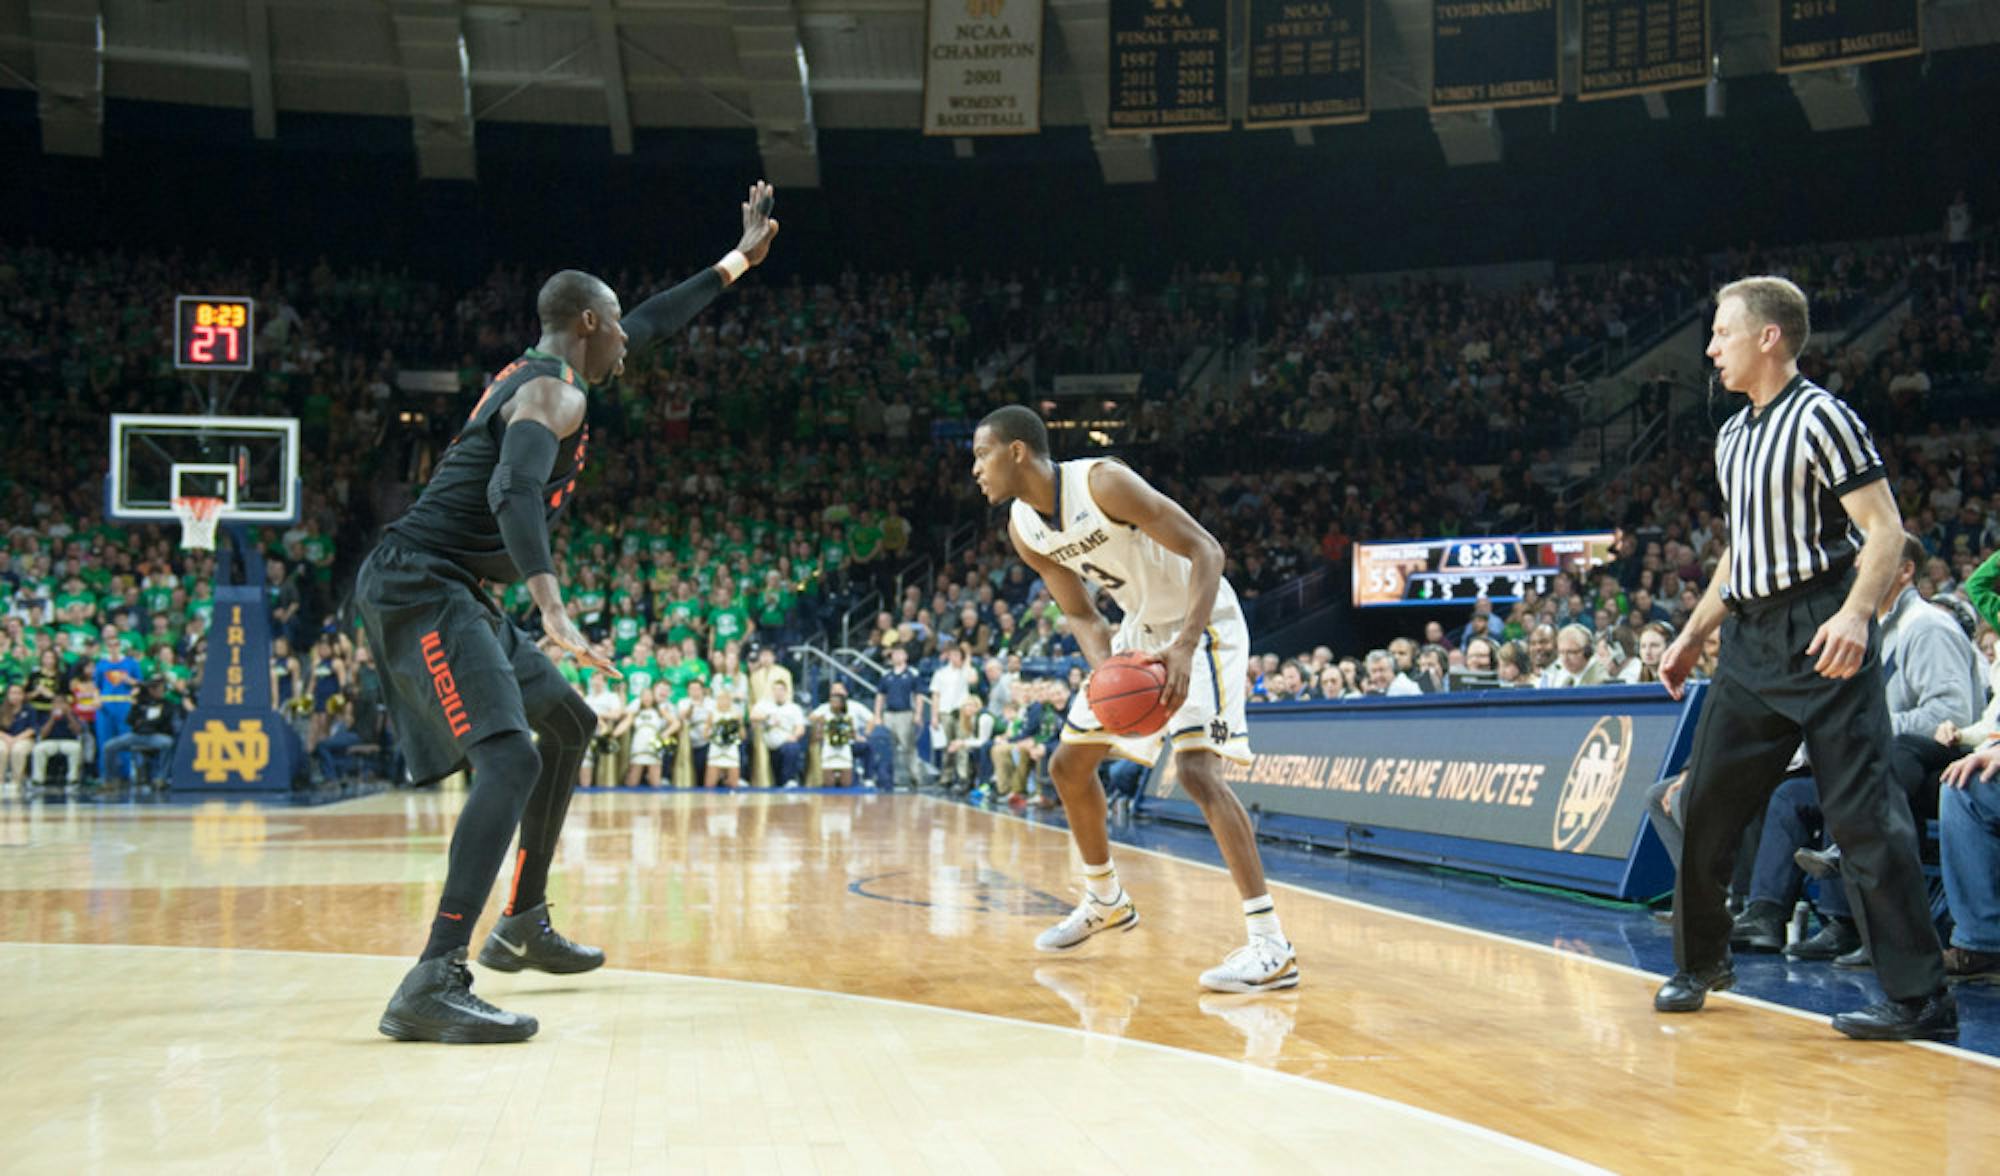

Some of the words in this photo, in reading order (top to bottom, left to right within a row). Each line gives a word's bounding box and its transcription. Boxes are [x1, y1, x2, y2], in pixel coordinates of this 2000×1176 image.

[955, 24, 1012, 41] NCAA
[1143, 14, 1193, 28] NCAA
[1116, 31, 1168, 45] FINAL
[1172, 29, 1220, 44] FOUR
[932, 43, 1035, 60] CHAMPION
[963, 69, 1002, 86] 2001
[949, 94, 1017, 110] WOMEN'S
[936, 112, 1025, 128] BASKETBALL
[197, 303, 246, 328] 8:23
[190, 324, 239, 362] 27
[1078, 528, 1110, 555] AME
[1458, 543, 1506, 568] 8:23
[1081, 561, 1127, 589] 3
[1368, 567, 1398, 594] 55
[225, 606, 245, 705] IRISH
[1250, 753, 1330, 789] BASKETBALL
[1326, 756, 1367, 792] HALL
[1366, 757, 1398, 793] OF
[1388, 758, 1443, 798] FAME
[1437, 761, 1547, 807] INDUCTEE
